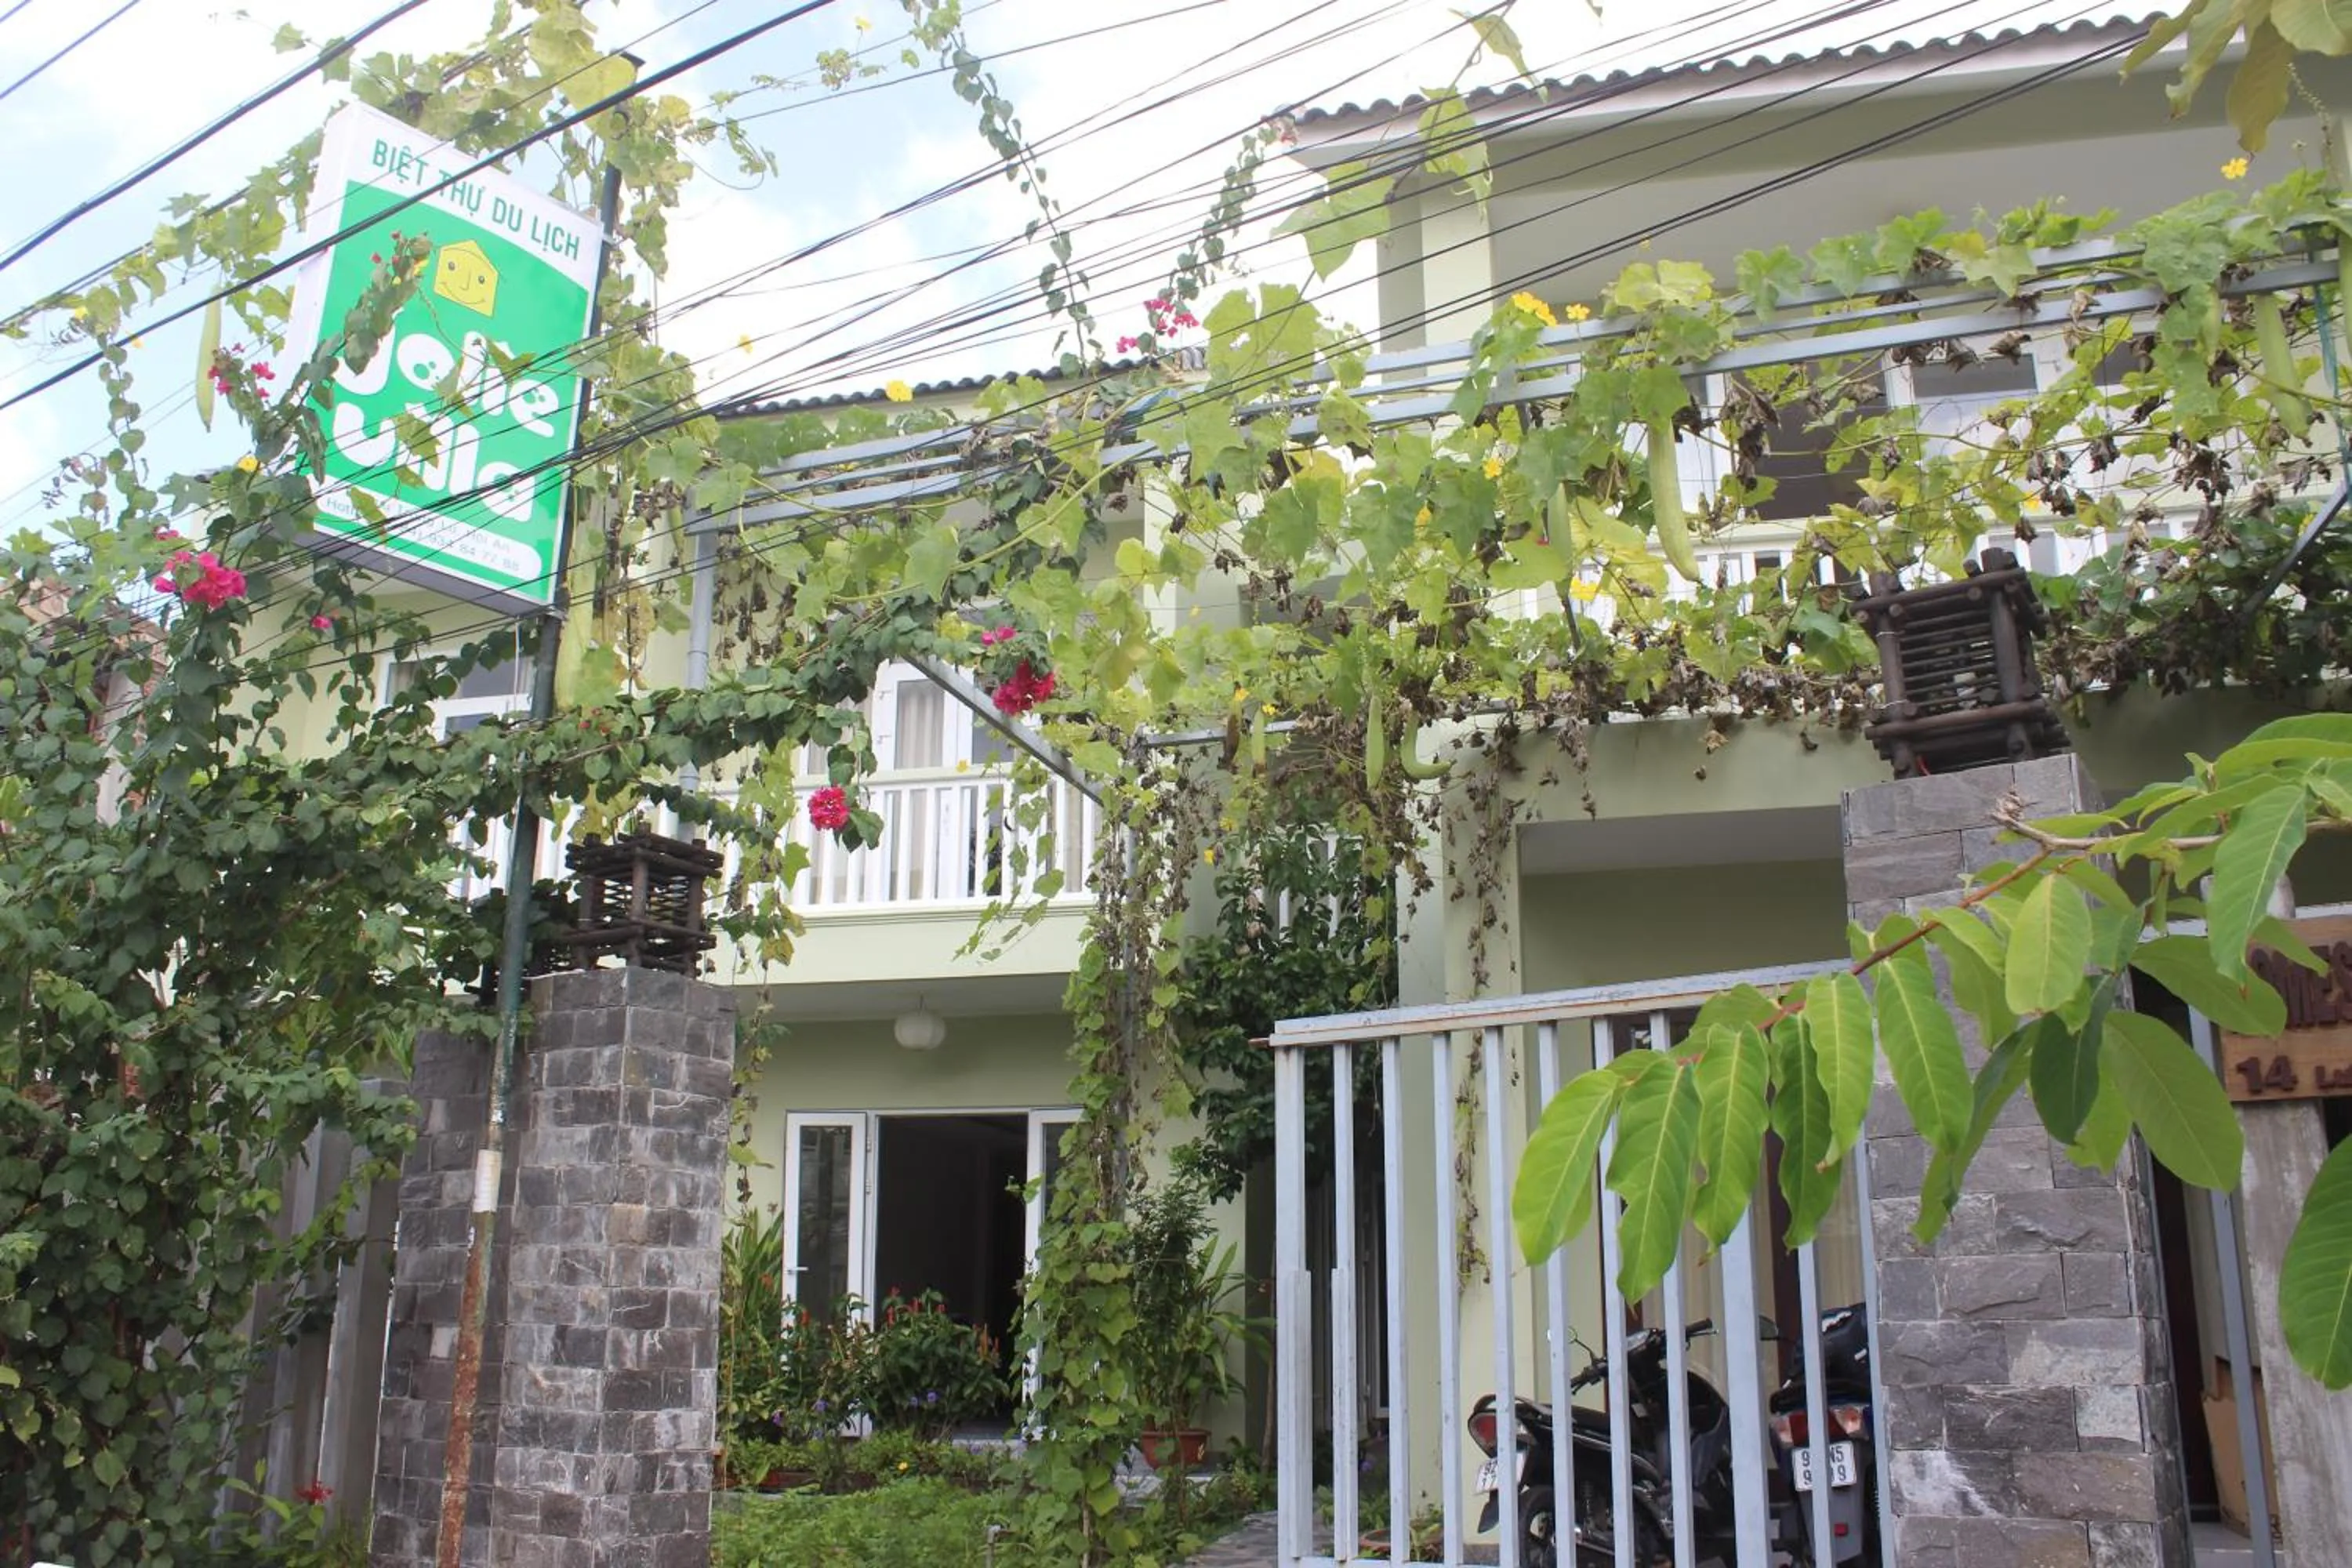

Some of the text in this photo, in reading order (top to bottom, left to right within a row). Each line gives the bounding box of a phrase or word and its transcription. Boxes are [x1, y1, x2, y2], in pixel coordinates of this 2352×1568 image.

[372, 138, 580, 261] BIỆT THỰ DU LỊCH
[2236, 1055, 2299, 1094] 14
